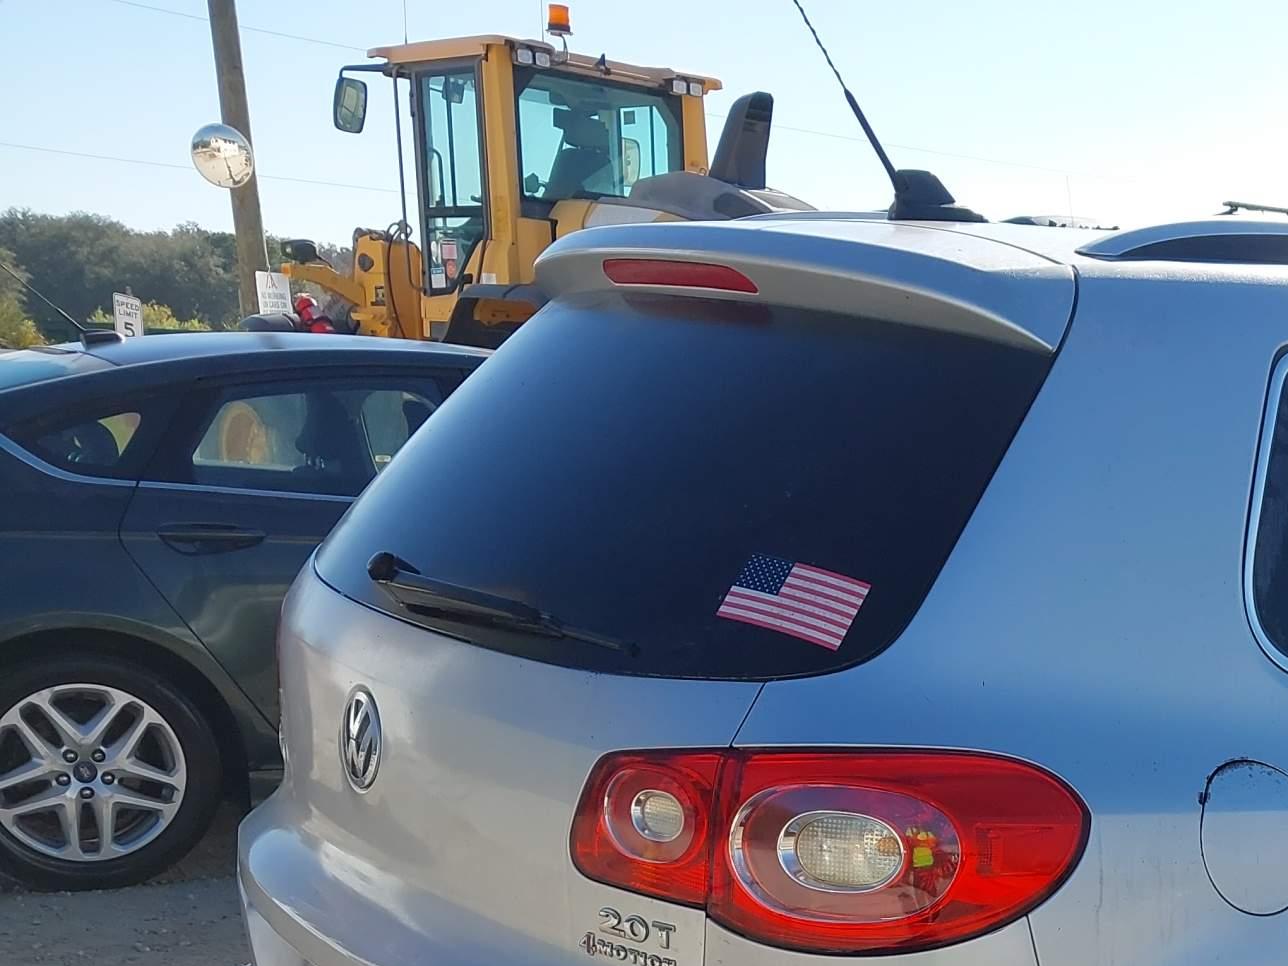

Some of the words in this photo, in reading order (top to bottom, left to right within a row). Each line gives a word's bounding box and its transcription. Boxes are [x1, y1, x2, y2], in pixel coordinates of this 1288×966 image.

[116, 299, 140, 311] SPEED
[119, 308, 137, 319] LIMIT
[124, 321, 135, 337] 5
[341, 687, 381, 790] VW
